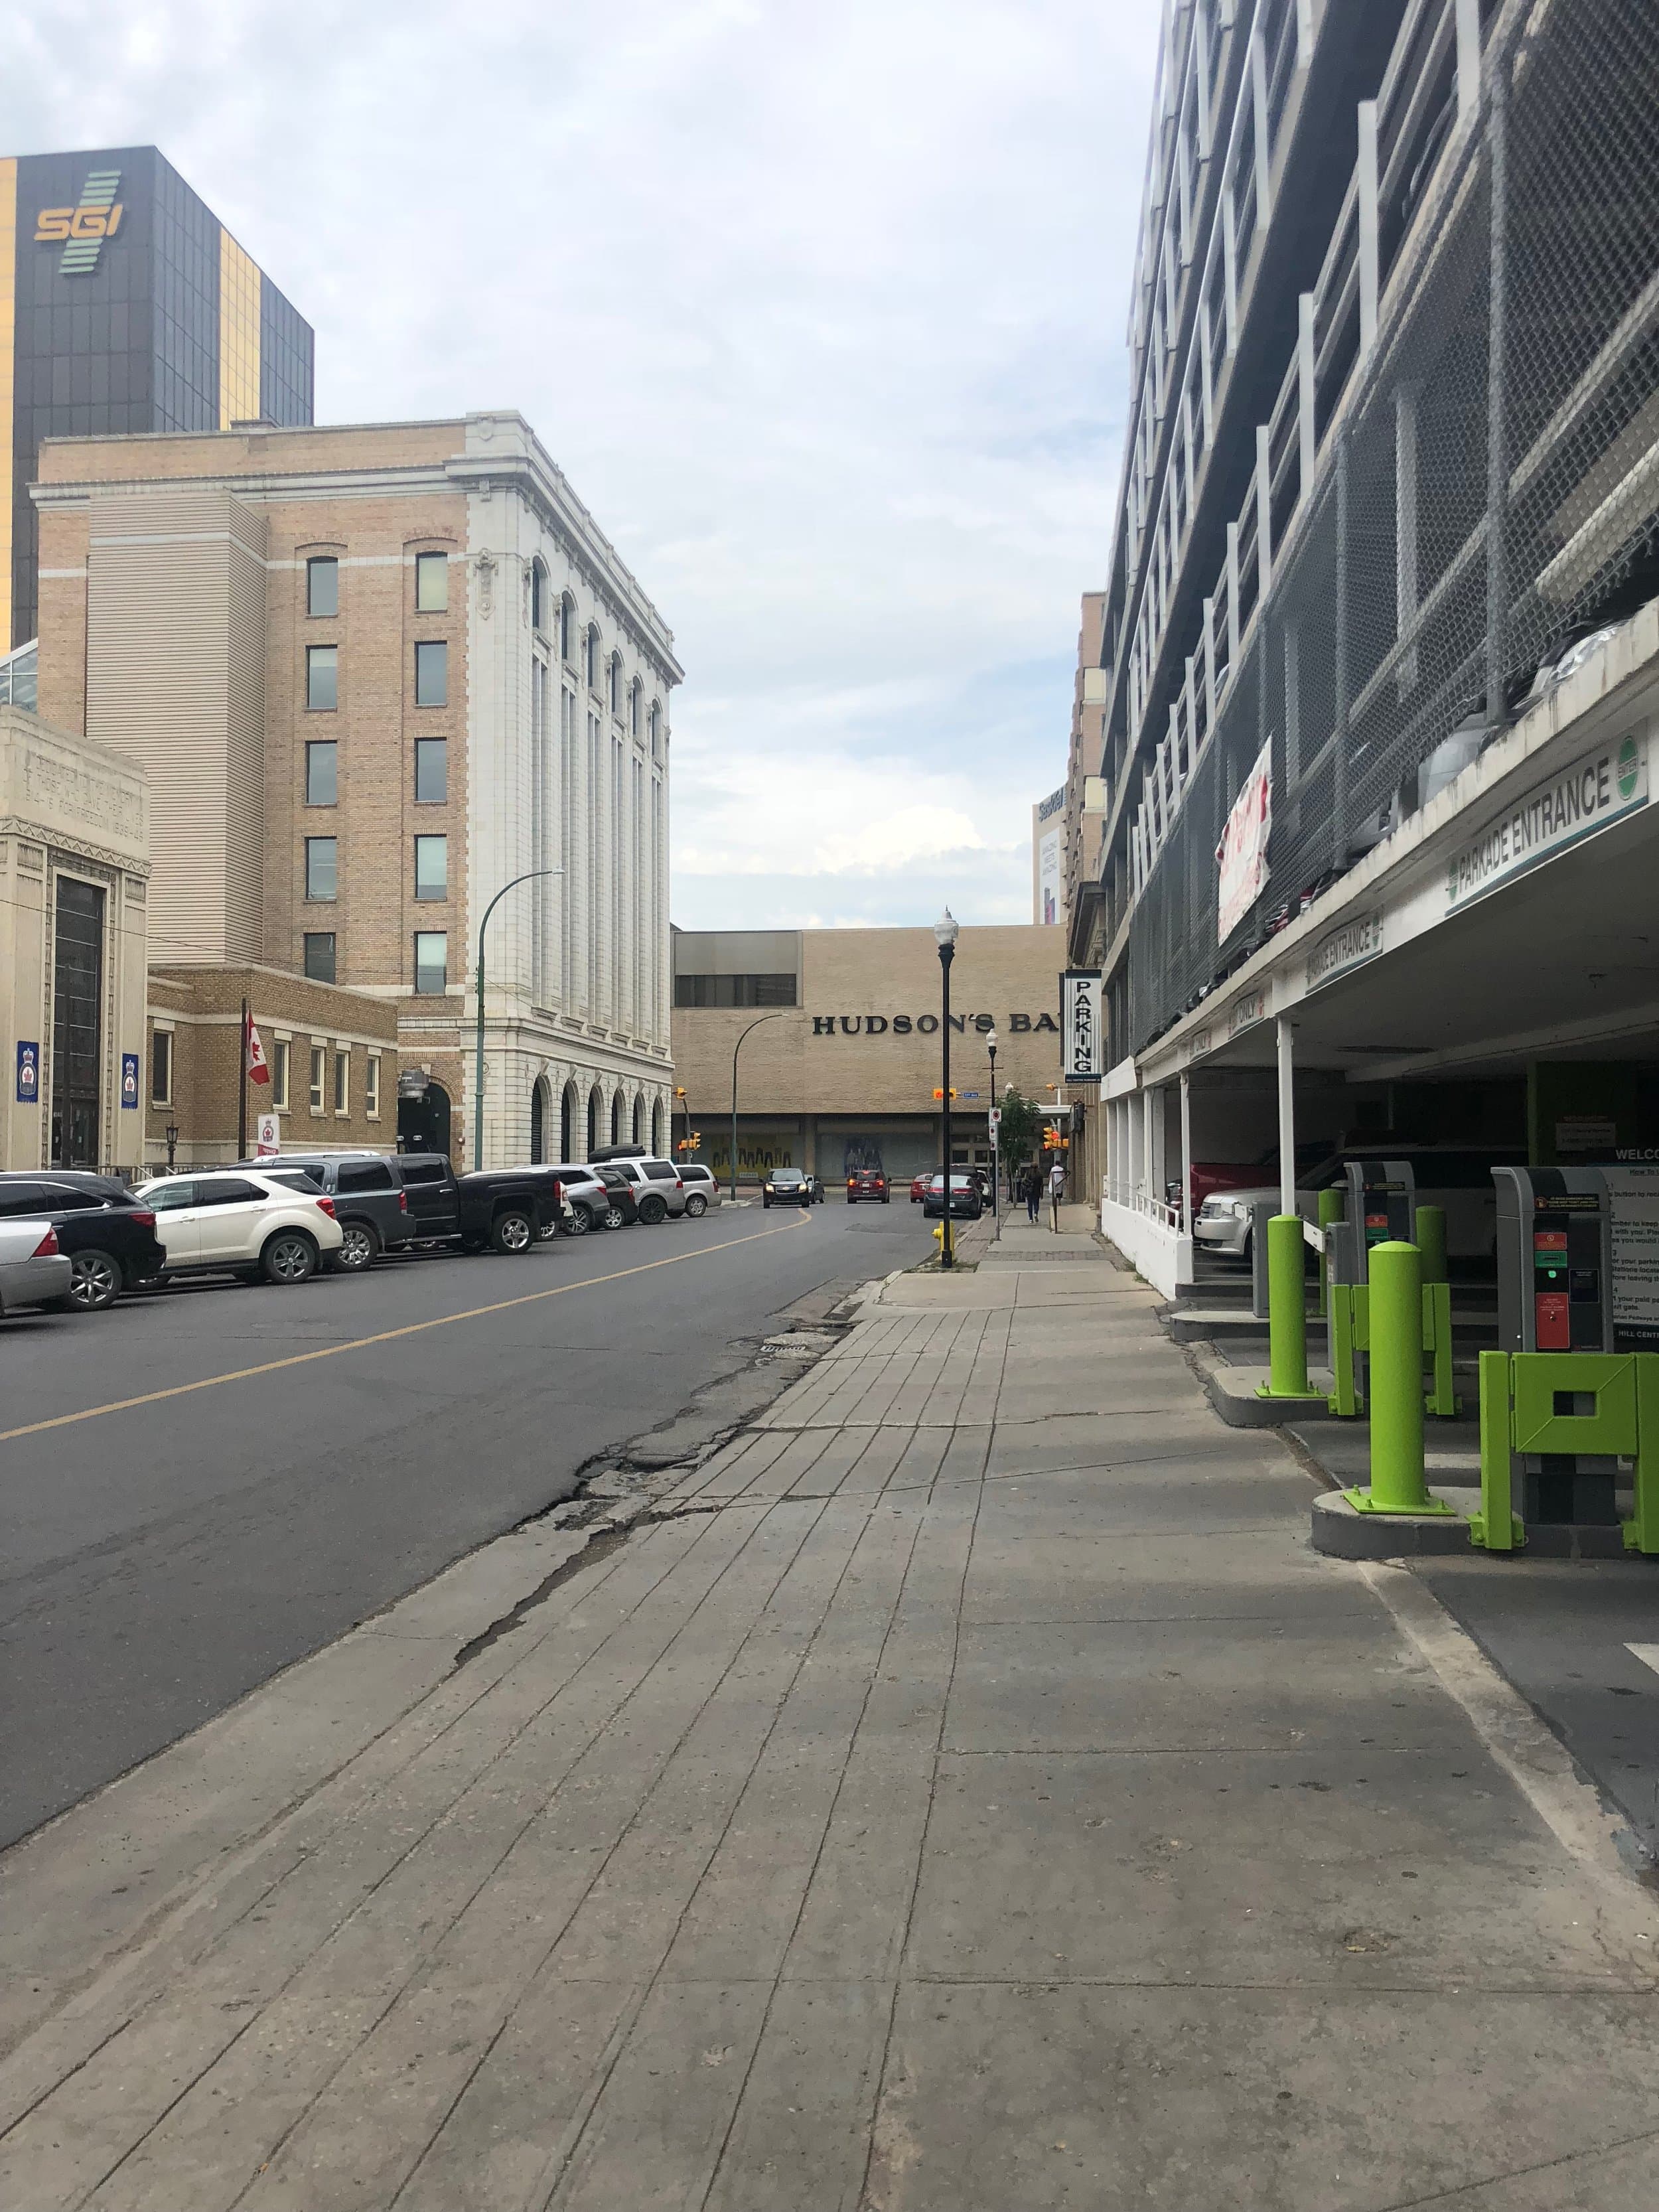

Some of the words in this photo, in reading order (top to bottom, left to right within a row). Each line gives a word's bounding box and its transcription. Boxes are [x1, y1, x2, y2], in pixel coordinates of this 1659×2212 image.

[34, 204, 123, 241] SGI
[1460, 822, 1509, 893] PARKADE
[1512, 757, 1610, 857] ENTRANCE
[1329, 921, 1370, 968] ENTRANCE
[812, 1014, 995, 1035] HUDSON'S
[1009, 1013, 1060, 1033] BA
[1074, 982, 1092, 1072] PARKING
[1628, 1274, 1652, 1283] leaving
